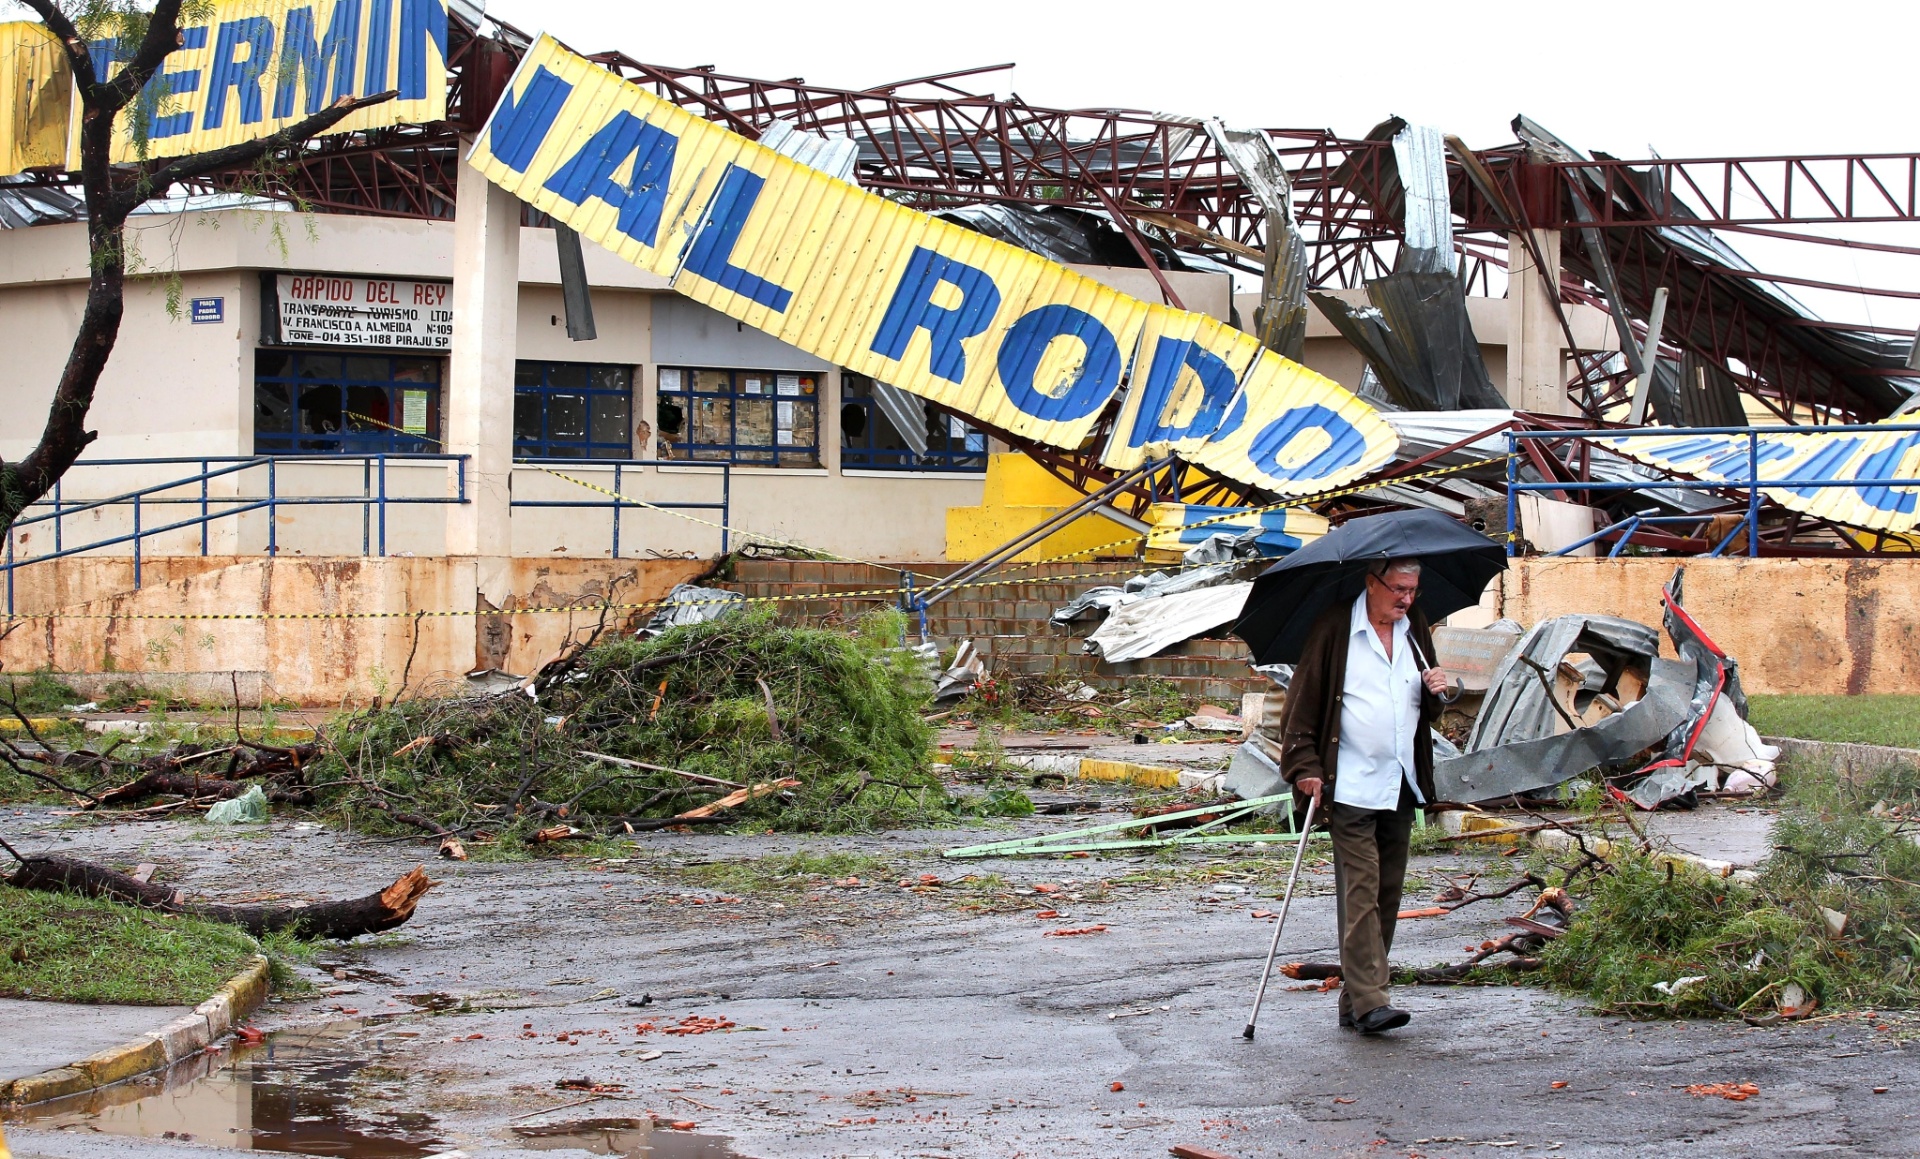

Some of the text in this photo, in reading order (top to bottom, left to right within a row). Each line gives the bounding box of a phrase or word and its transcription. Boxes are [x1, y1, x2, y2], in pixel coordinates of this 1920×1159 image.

[291, 276, 446, 306] RÁPIDO DEL REY
[283, 302, 358, 318] TRANSPORTE
[296, 317, 352, 331] FRANCISCO
[354, 322, 363, 331] A.
[366, 322, 412, 333] ALMEIDA
